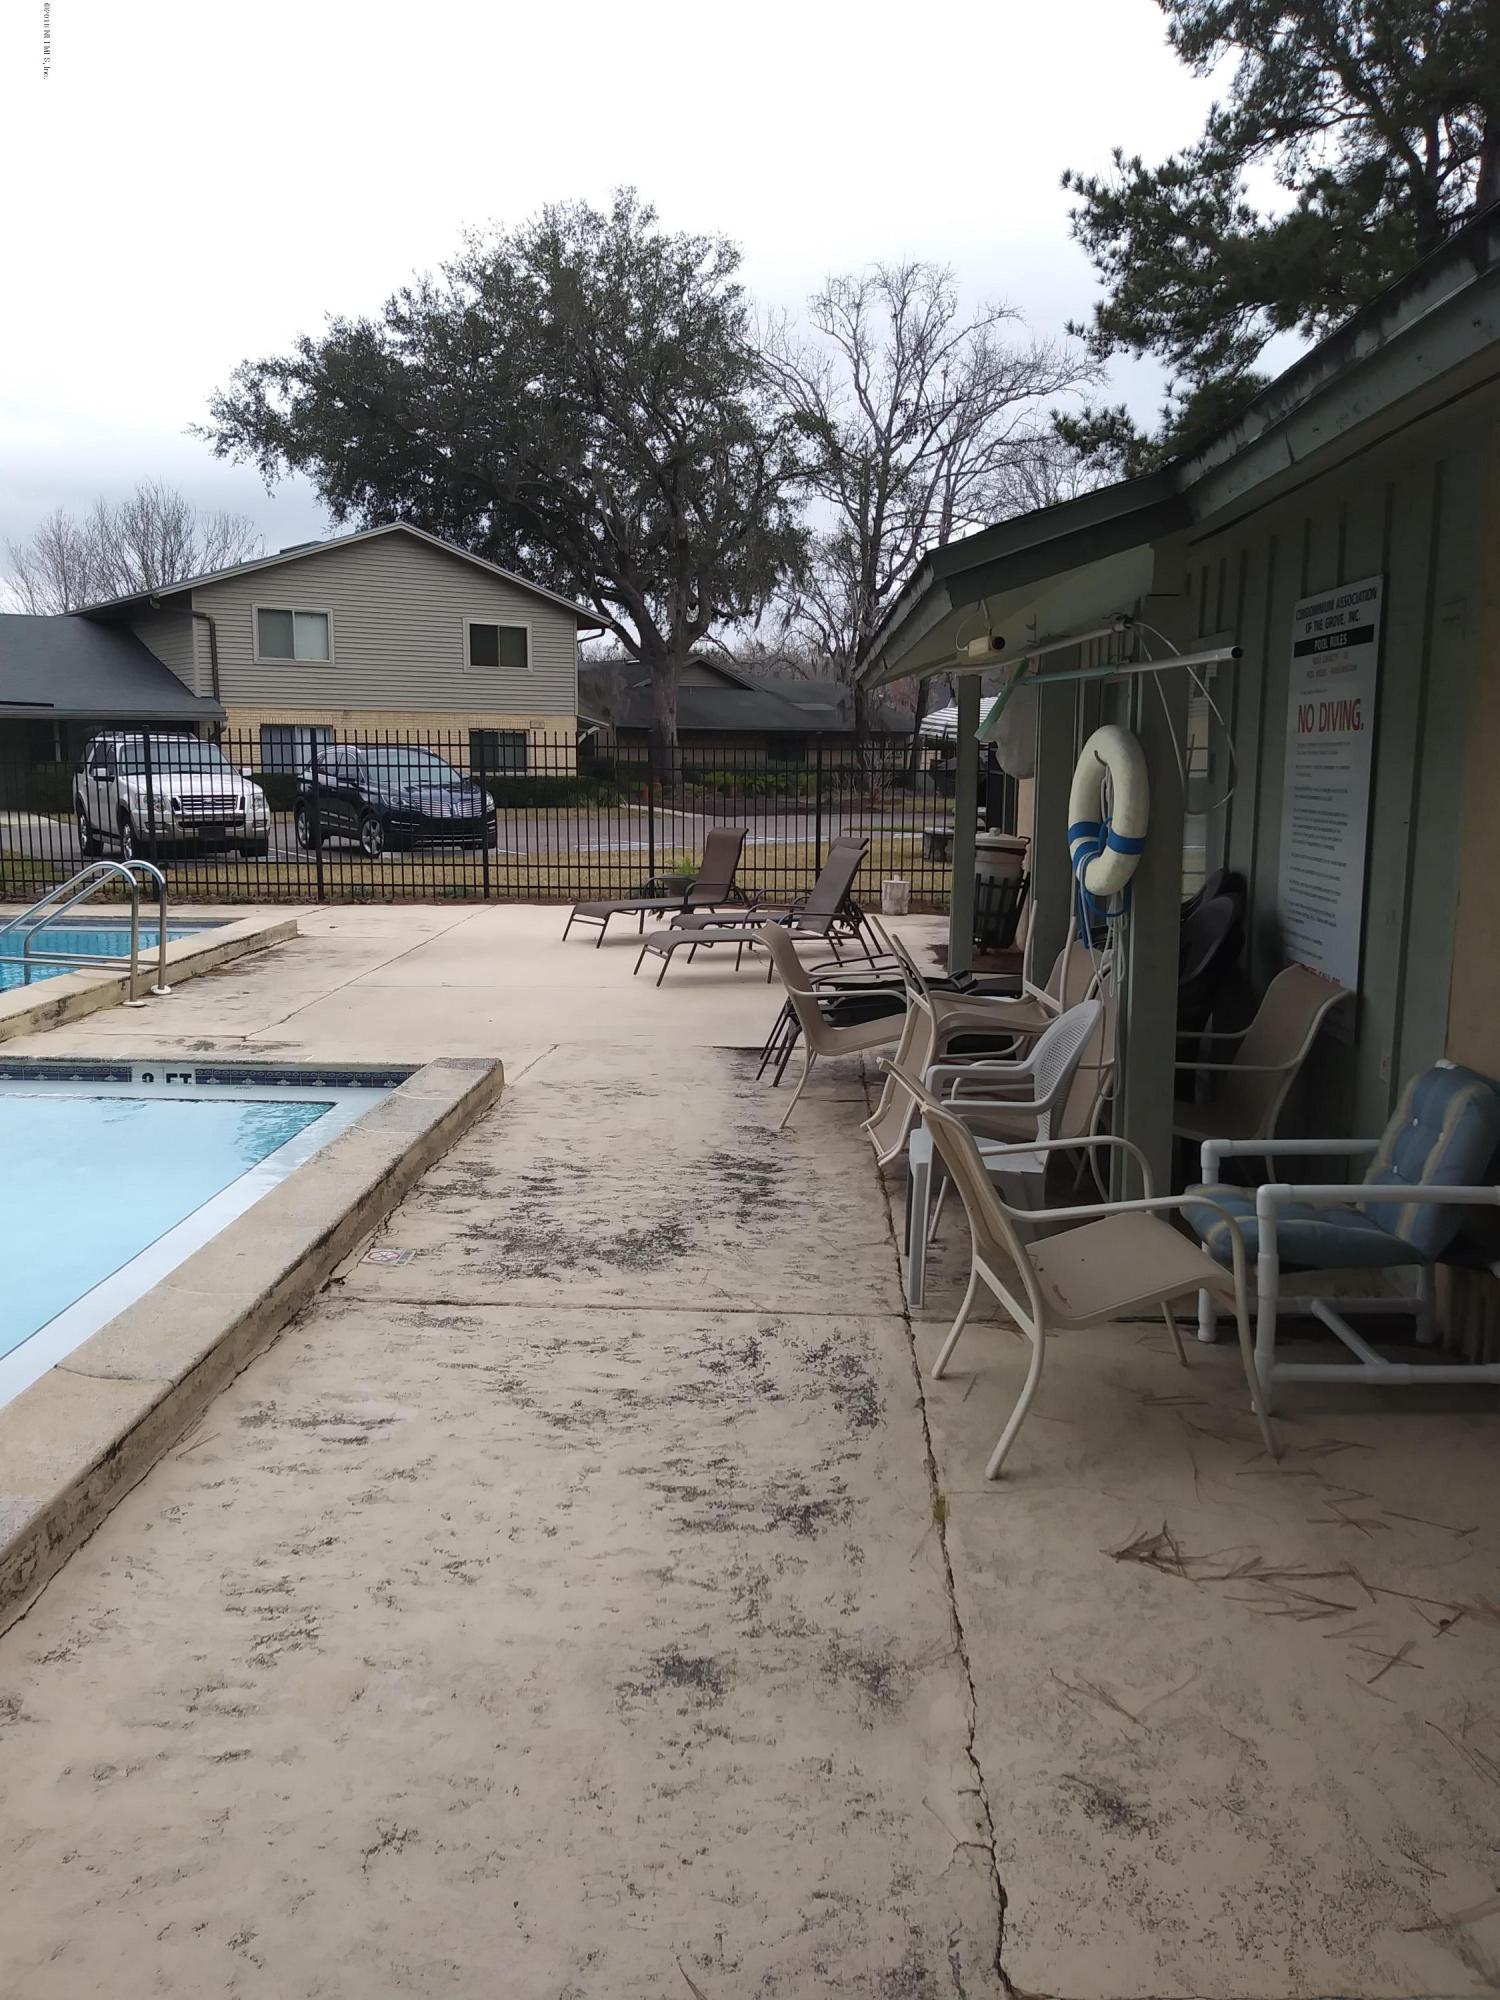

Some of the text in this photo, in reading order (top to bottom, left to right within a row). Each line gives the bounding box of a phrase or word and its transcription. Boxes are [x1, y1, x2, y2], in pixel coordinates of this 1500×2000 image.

[1295, 587, 1377, 621] CONDOMINIUM ASSOCIATION
[1305, 622, 1313, 634] OF
[1313, 619, 1324, 632] THE
[1348, 609, 1361, 623] INC.
[1314, 633, 1348, 652] POOL RULES
[1297, 698, 1364, 734] NO DIVING.
